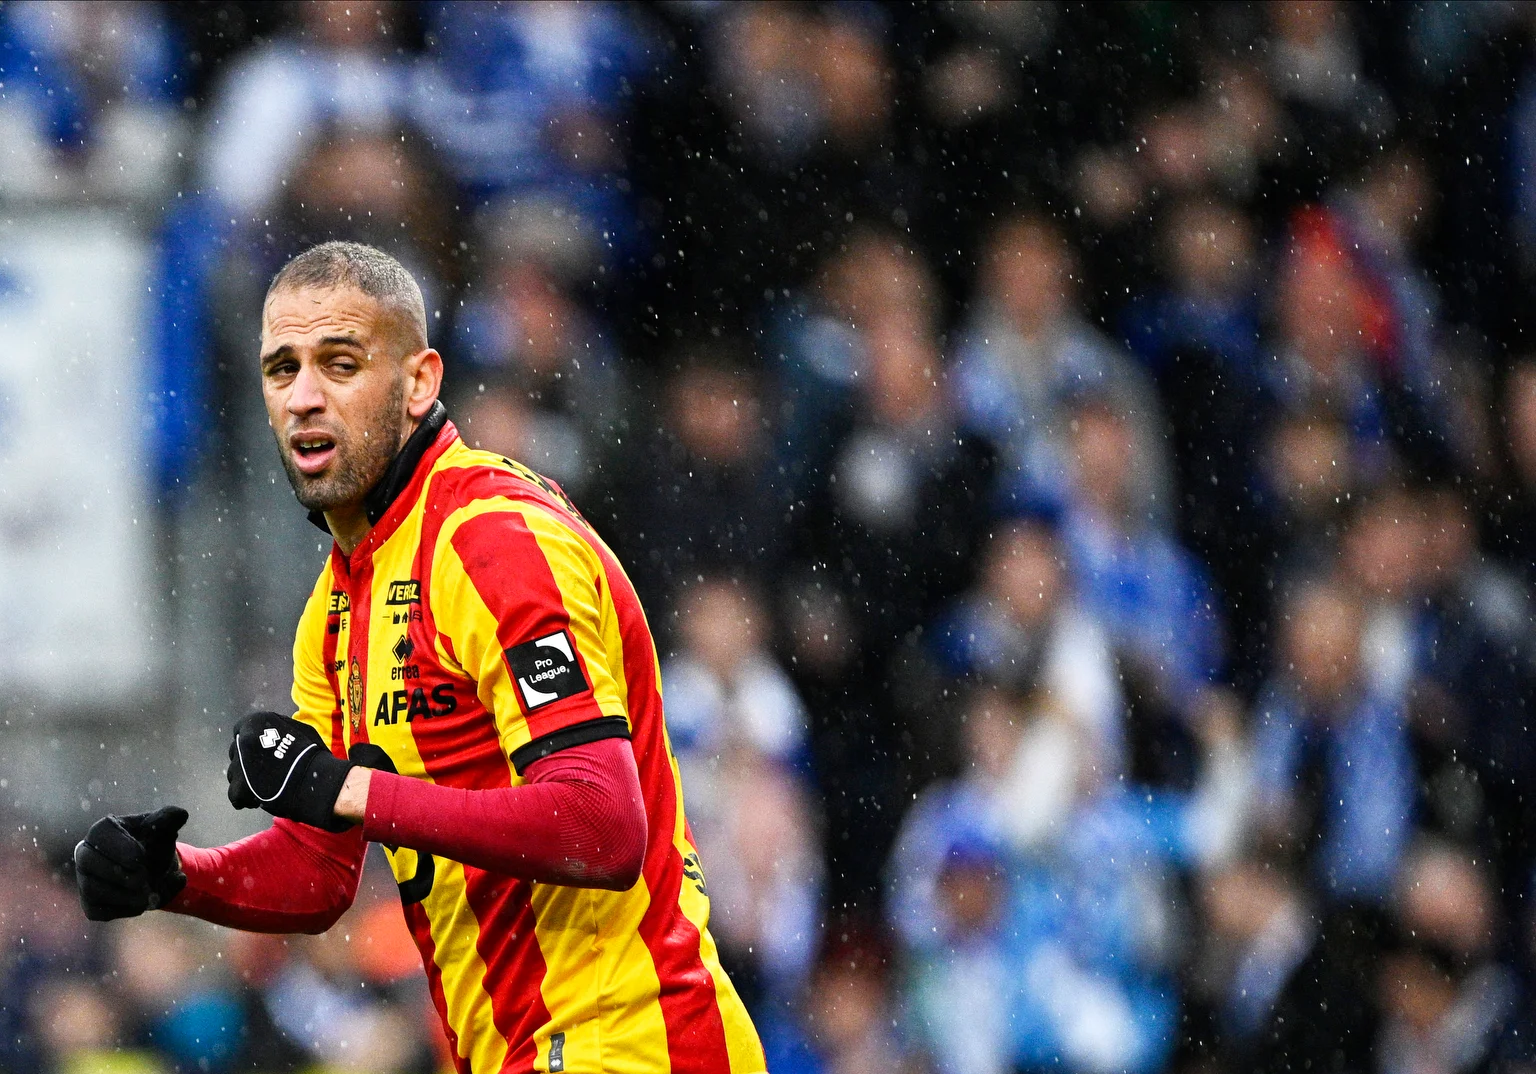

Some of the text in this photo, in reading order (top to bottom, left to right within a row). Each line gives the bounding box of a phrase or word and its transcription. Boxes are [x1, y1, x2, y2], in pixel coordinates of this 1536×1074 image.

[391, 663, 420, 680] errea
[534, 658, 553, 670] Pro
[529, 665, 567, 684] League
[374, 683, 458, 727] AFAS
[273, 733, 296, 759] errea
